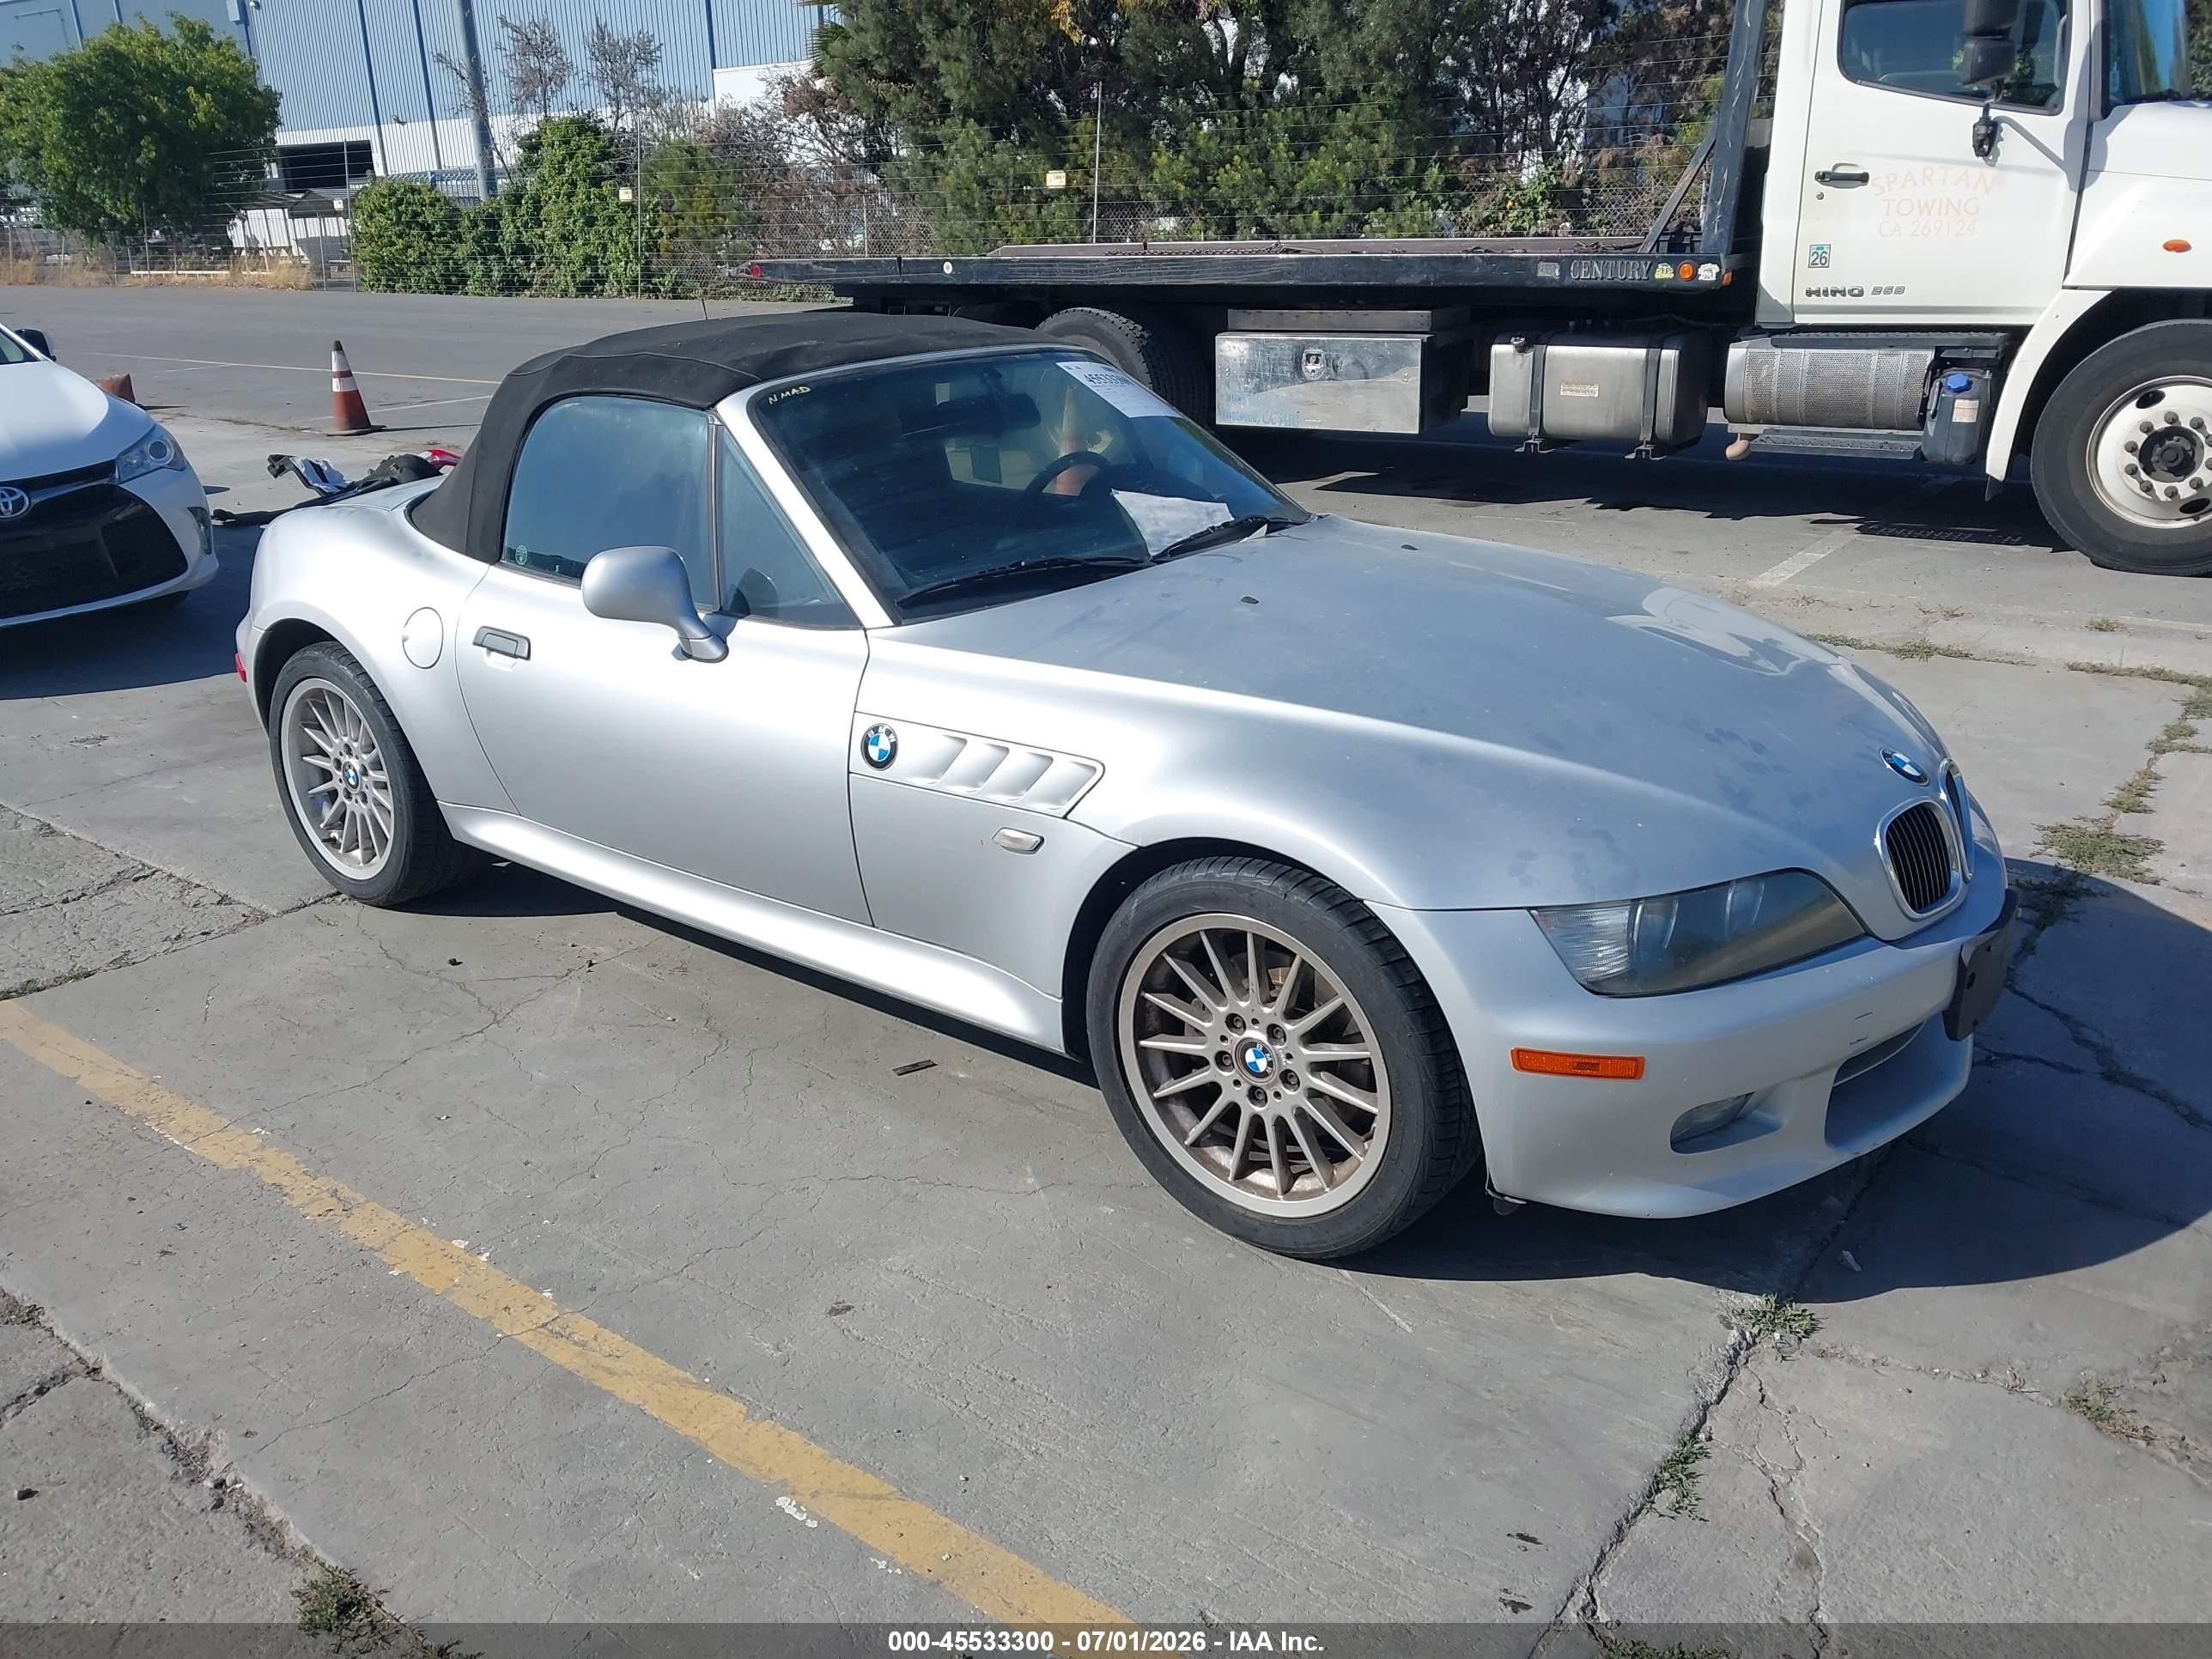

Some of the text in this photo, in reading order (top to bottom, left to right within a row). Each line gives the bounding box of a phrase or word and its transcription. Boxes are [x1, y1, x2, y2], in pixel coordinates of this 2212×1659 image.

[1870, 166, 1995, 197] SPARTAN
[1881, 197, 1979, 216] TOWING
[1878, 219, 1902, 238] CA
[1810, 251, 1828, 266] 26
[1570, 259, 1653, 281] CENTURY
[1805, 287, 1864, 297] HINO
